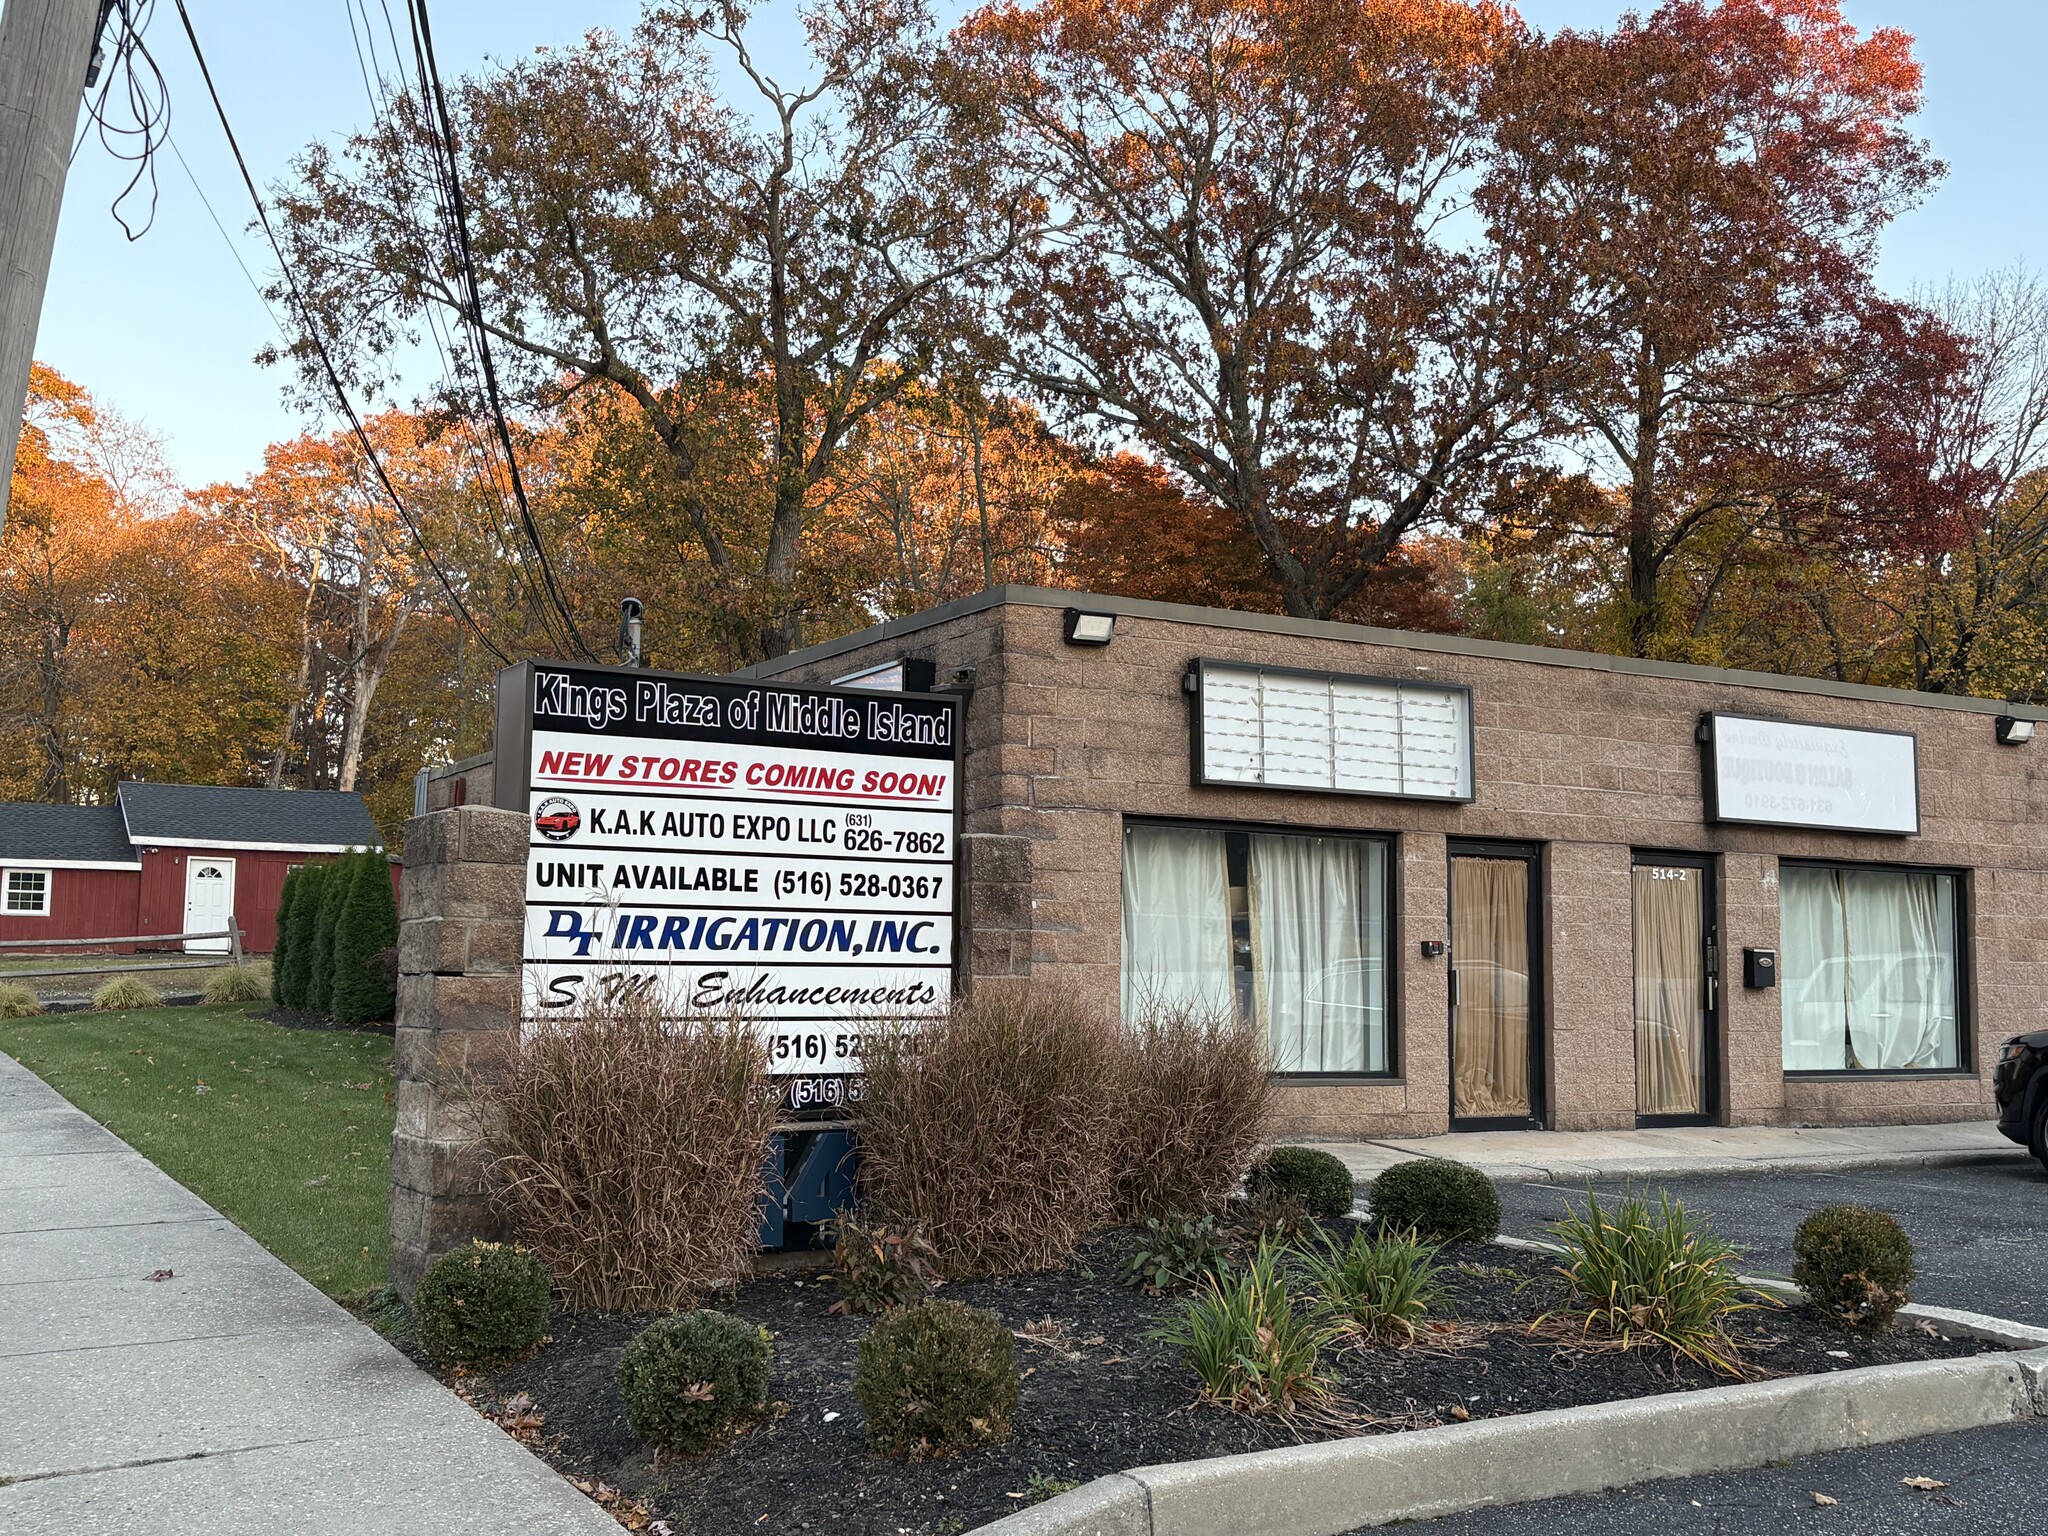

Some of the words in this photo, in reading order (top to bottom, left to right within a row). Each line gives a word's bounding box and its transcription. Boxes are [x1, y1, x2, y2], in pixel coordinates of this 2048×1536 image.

[534, 672, 627, 729] Kings
[636, 681, 720, 727] Plaza
[728, 691, 760, 730] of
[766, 692, 860, 738] Middle
[867, 702, 951, 745] Island
[538, 751, 613, 776] NEW
[618, 756, 738, 784] STORES
[745, 763, 855, 791] COMING
[861, 771, 946, 796] SOON!
[590, 808, 656, 836] K.A.K
[661, 811, 725, 839] AUTO
[732, 815, 790, 842] EXPO
[798, 818, 836, 843] LLC
[845, 813, 872, 828] (631)
[844, 829, 945, 854] 626-7862
[536, 862, 604, 888] UNIT
[613, 864, 758, 892] AVAILABLE
[774, 869, 832, 901] (516)
[839, 873, 943, 899] 528-0367
[1652, 868, 1686, 881] 514-2
[543, 910, 603, 956] DT
[540, 975, 584, 1008] S
[692, 971, 936, 1008] Enhancements
[768, 1034, 827, 1065] (516)
[791, 1079, 844, 1108] (516)
